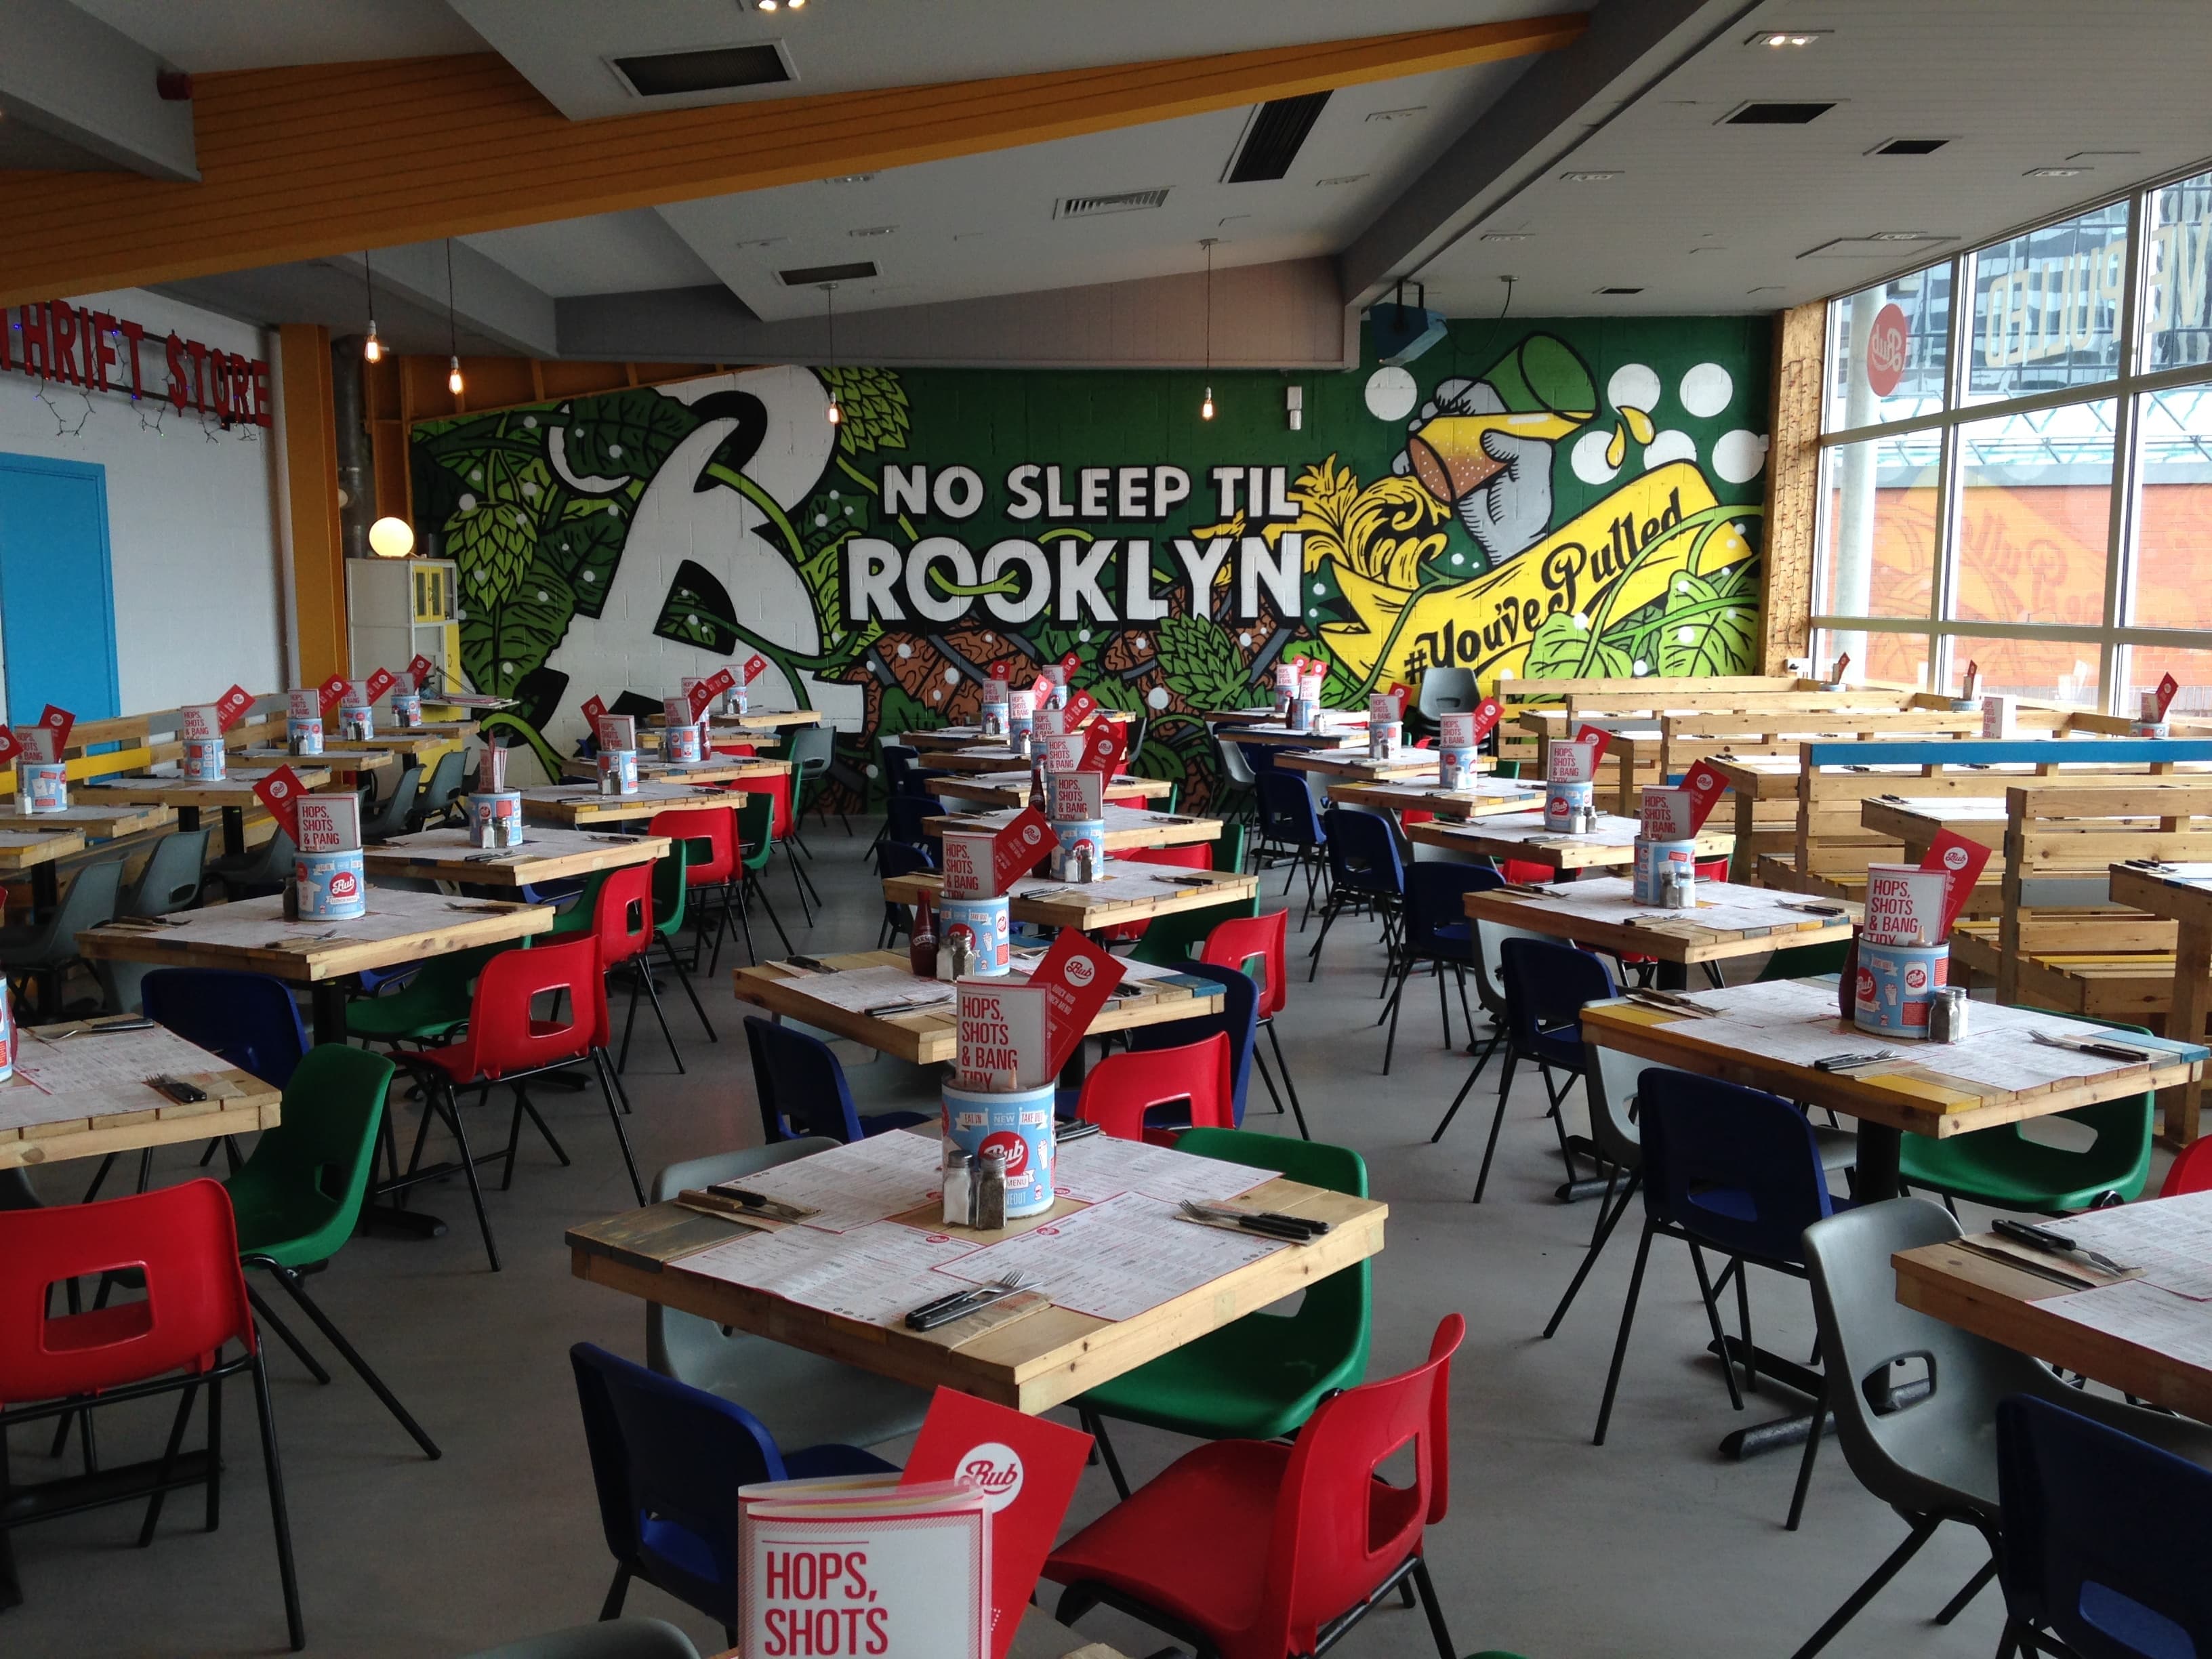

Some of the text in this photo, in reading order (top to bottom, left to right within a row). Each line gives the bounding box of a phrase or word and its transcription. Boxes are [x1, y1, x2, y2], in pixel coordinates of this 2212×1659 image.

[883, 464, 1303, 520] NO SLEEP TIL
[1542, 486, 1684, 615] Pulled
[847, 533, 1303, 622] ROOKLYN
[1059, 779, 1080, 791] HOPS,
[1059, 791, 1082, 801] SHOTS
[1059, 802, 1087, 812] & BANG
[1644, 808, 1671, 821] SHOTS
[303, 819, 333, 831] SHOTS
[1653, 821, 1675, 834] BANG
[313, 833, 340, 844] BANG
[946, 844, 970, 859] HOPS,
[946, 859, 972, 874] SHOTS
[946, 875, 979, 890] & BANG
[1873, 879, 1910, 899] HOPS,
[1871, 898, 1913, 915] SHOTS
[1870, 916, 1918, 933] & BANG
[1066, 960, 1092, 979] Rub
[962, 996, 1004, 1022] HOPS,
[962, 1021, 1008, 1046] SHOTS
[962, 1047, 1017, 1071] & BANG
[994, 1115, 1015, 1123] NEW
[1007, 1175, 1027, 1186] MENU
[766, 1551, 878, 1603] HOPS,
[764, 1608, 888, 1656] SHOTS
